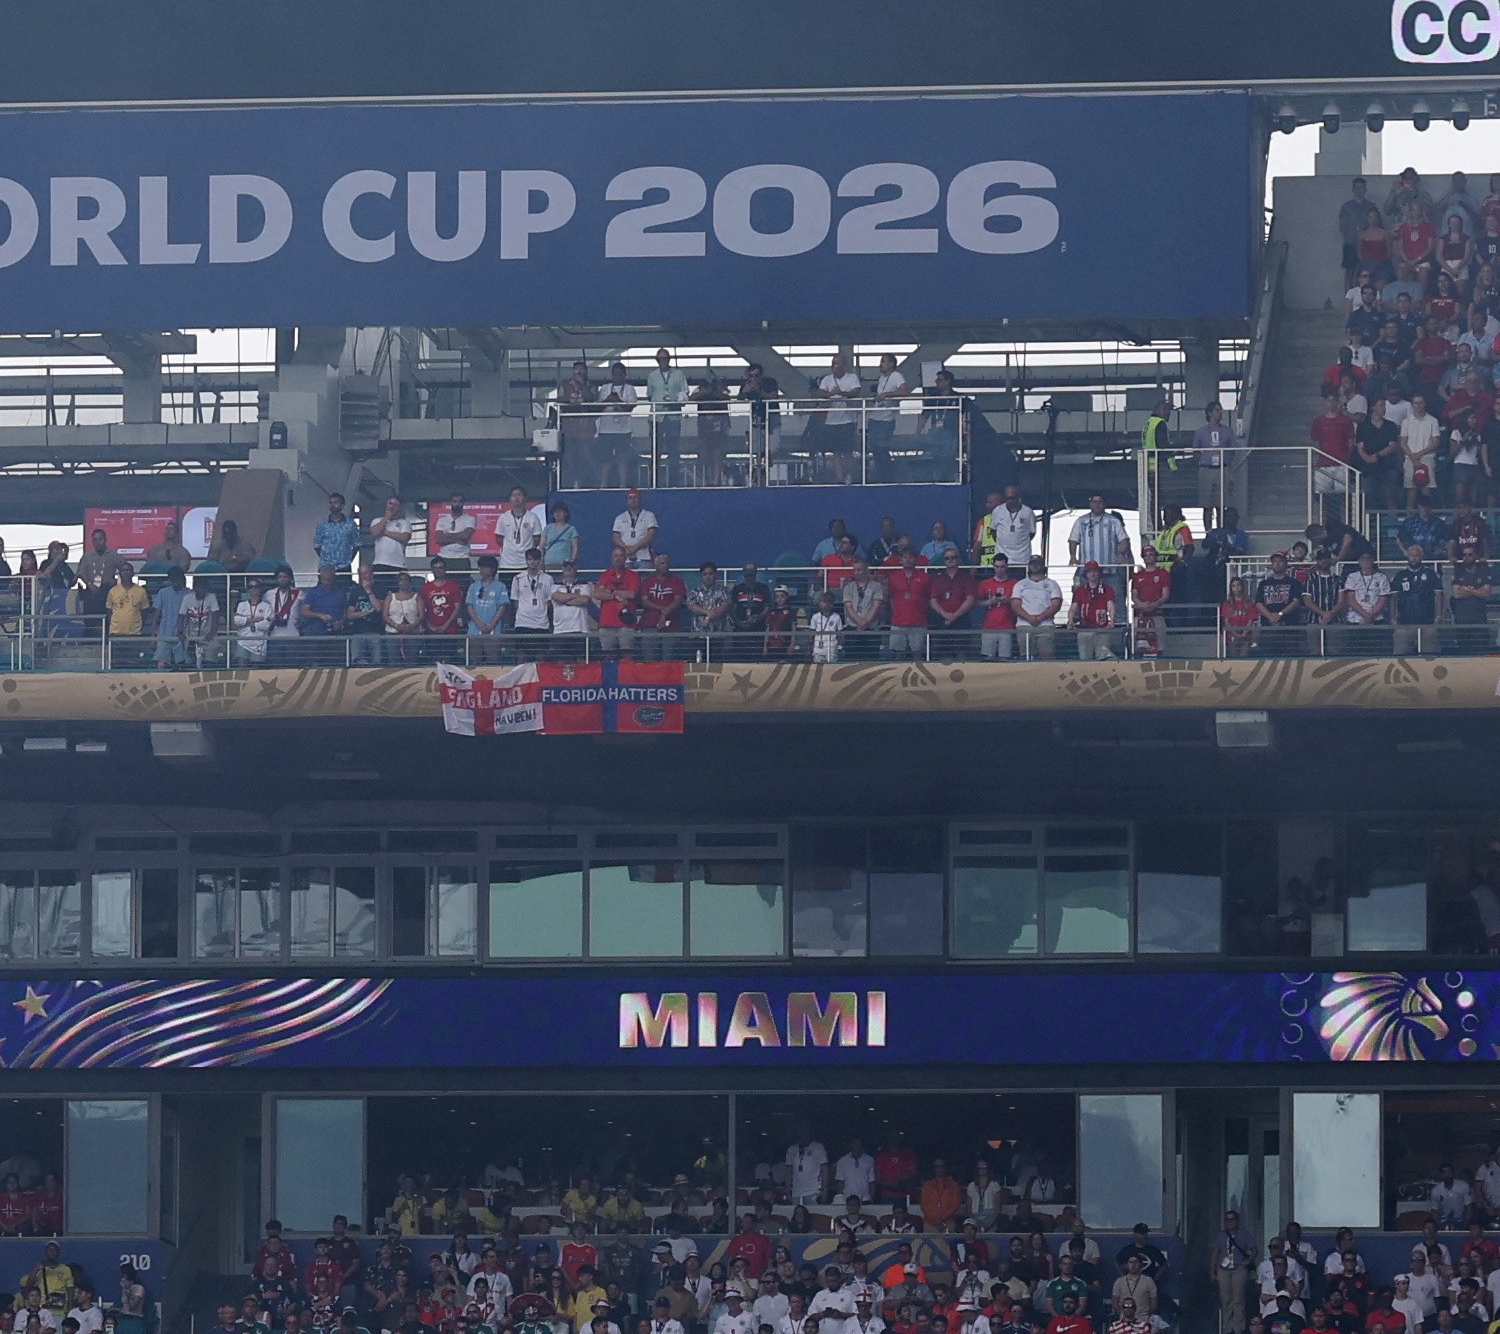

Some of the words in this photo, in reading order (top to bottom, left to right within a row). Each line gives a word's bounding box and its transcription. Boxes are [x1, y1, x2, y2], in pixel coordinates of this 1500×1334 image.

[1401, 0, 1490, 56] CC
[322, 169, 577, 263] CUP
[604, 160, 1060, 258] 2026
[618, 990, 887, 1048] MIAMI
[120, 1255, 151, 1270] 210
